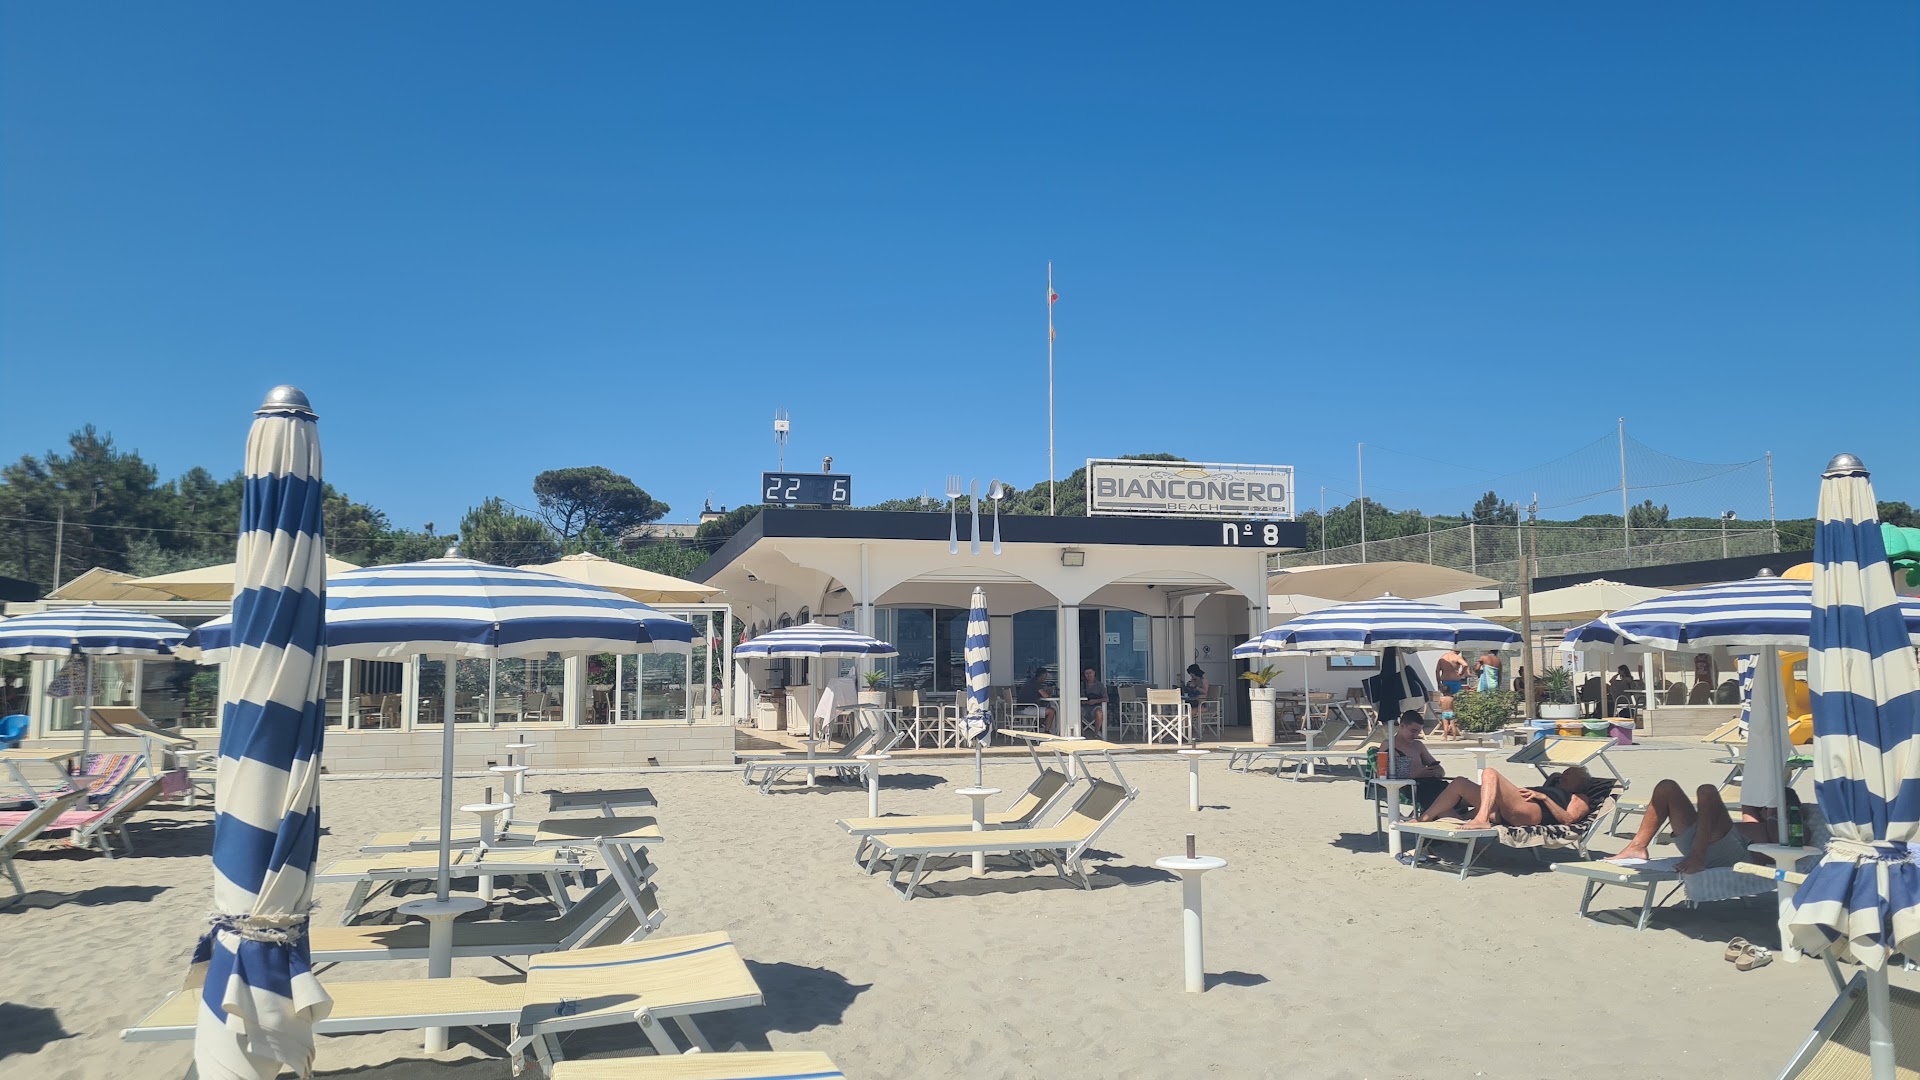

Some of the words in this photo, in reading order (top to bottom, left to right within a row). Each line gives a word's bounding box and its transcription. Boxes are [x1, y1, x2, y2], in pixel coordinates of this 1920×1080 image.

[766, 477, 801, 500] 22
[832, 479, 847, 501] 6
[1097, 477, 1285, 503] BIANCONERO
[1167, 502, 1219, 512] BEACH
[1263, 524, 1279, 546] 8
